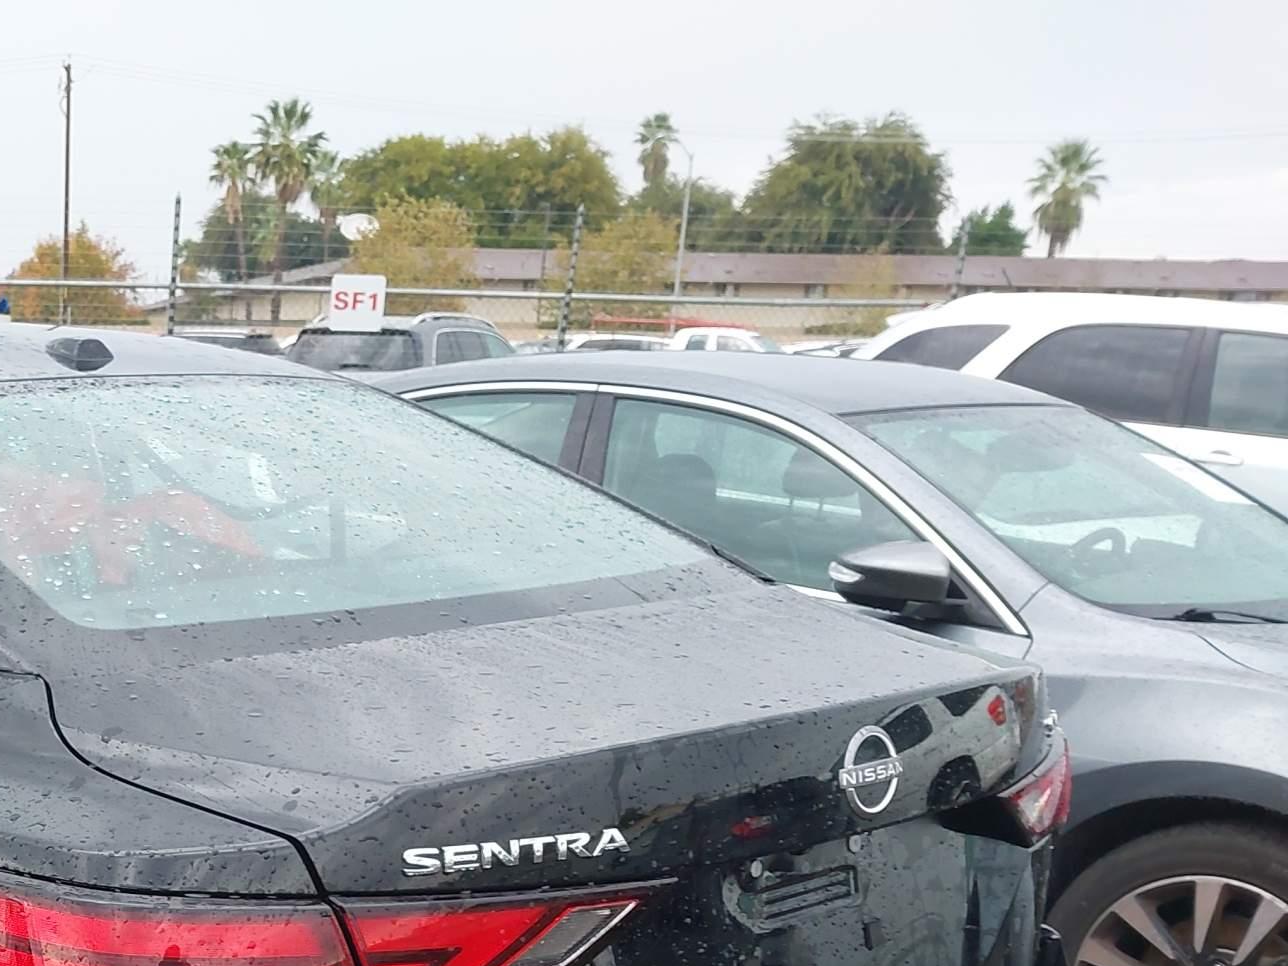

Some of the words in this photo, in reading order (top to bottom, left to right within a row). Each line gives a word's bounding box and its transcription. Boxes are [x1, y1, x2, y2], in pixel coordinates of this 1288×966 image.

[334, 291, 378, 311] SF1
[841, 761, 904, 786] NISSAN
[402, 827, 631, 877] SENTRA
